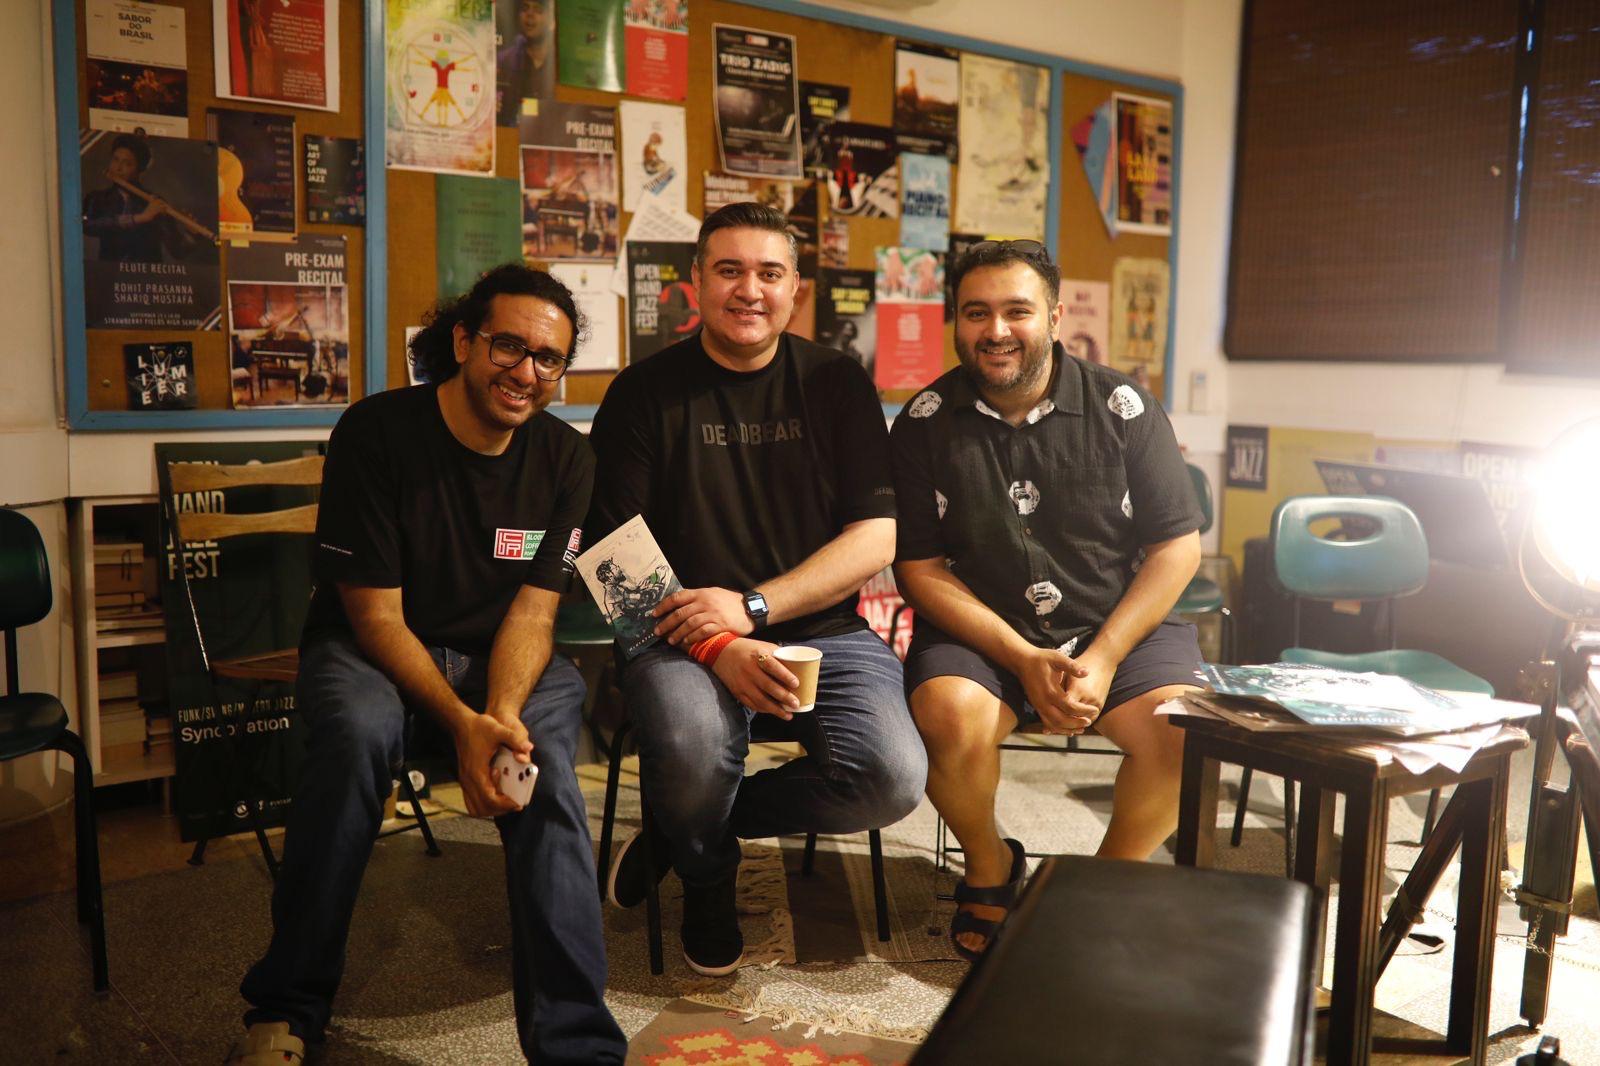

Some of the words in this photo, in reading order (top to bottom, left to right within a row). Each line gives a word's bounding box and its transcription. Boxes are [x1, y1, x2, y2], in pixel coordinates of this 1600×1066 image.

[118, 12, 152, 24] SABOR
[129, 22, 142, 30] DO
[119, 29, 154, 40] BRASIL
[307, 143, 319, 151] THE
[307, 151, 321, 159] ART
[307, 159, 317, 167] OF
[307, 166, 328, 175] LATIN
[308, 175, 326, 183] JAZZ
[285, 252, 344, 268] PRE-EXAM
[120, 262, 147, 273] FLUTE
[151, 263, 187, 275] RECITAL
[634, 263, 660, 280] OPEN
[298, 270, 344, 285] RECITAL
[114, 282, 142, 293] ROHIT
[146, 283, 193, 295] PRASANNA
[114, 293, 151, 305] SHARIQ
[152, 294, 193, 305] MUSTAFA
[702, 418, 802, 446] DEADBEAR
[1229, 446, 1264, 482] JAZZ
[1463, 451, 1517, 481] OPEN
[167, 551, 221, 581] FEST
